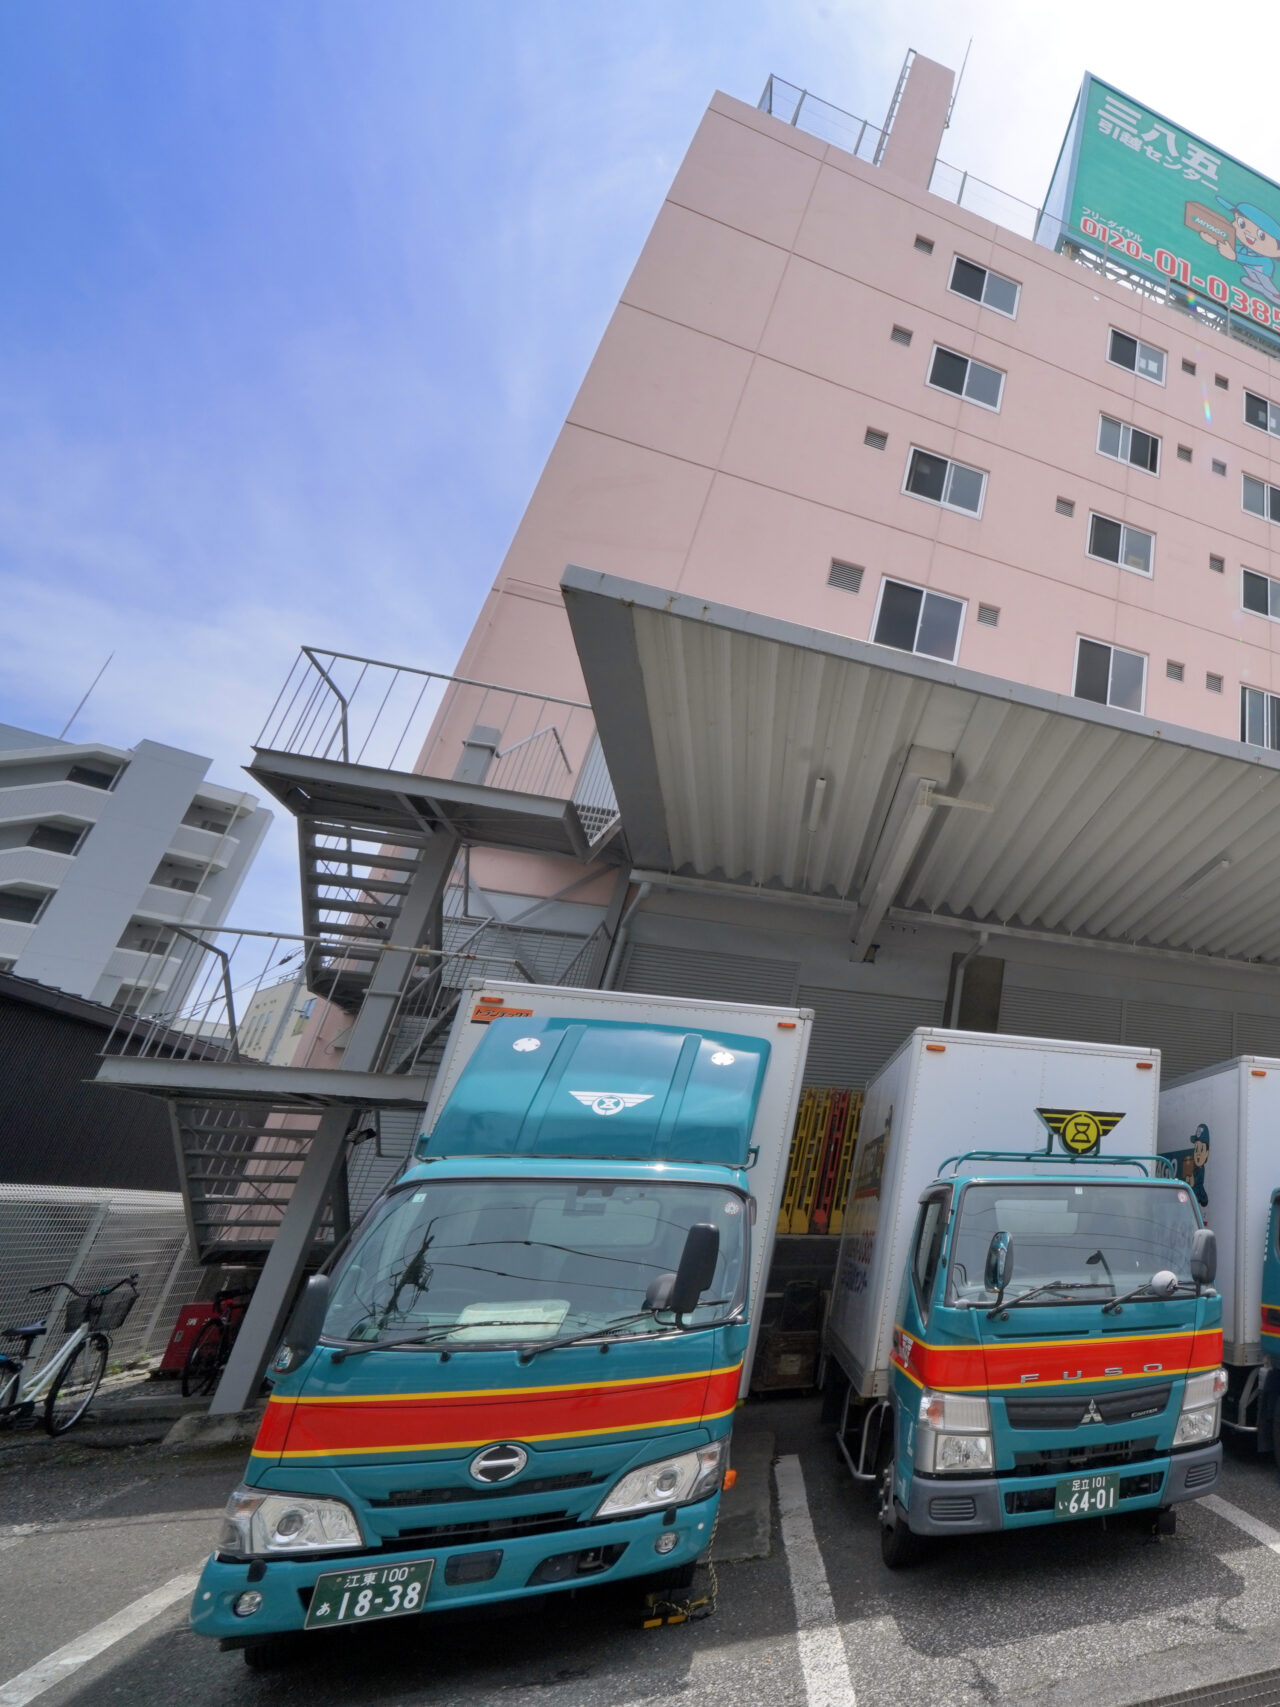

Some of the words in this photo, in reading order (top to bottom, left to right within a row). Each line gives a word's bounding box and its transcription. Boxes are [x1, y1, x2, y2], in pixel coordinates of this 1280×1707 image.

[1097, 95, 1221, 181] 三八五
[1097, 119, 1219, 191] 引越センター
[1081, 206, 1143, 242] フリーダイヤル
[1195, 216, 1227, 238] MIYAGO
[1020, 1363, 1163, 1384] FUSO
[1072, 1479, 1090, 1491] 足立
[1092, 1476, 1106, 1488] 101
[1058, 1500, 1068, 1510] い
[1069, 1487, 1114, 1513] 64-01
[343, 1571, 379, 1588] 江東
[381, 1566, 409, 1584] 100
[315, 1602, 331, 1616] あ
[337, 1582, 421, 1620] 18-38
